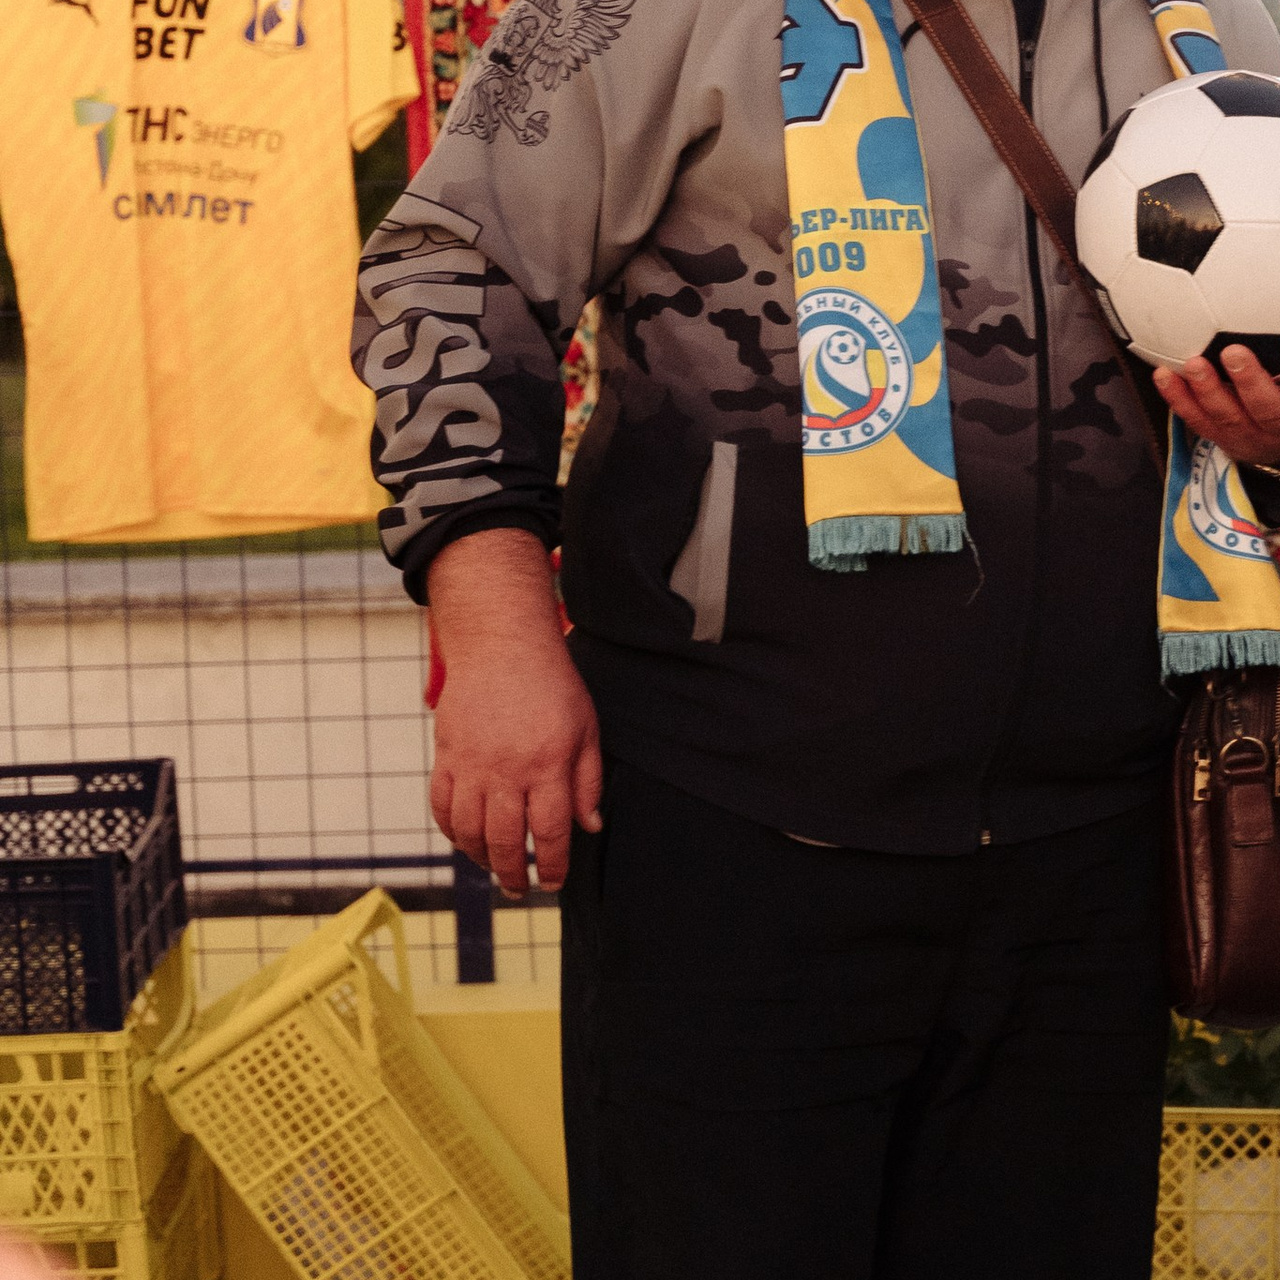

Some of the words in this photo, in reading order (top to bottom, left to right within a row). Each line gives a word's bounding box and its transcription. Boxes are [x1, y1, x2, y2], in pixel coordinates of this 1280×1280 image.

[134, 26, 205, 61] BET
[868, 315, 902, 366] КЛУБ
[358, 192, 504, 558] RUSSIA
